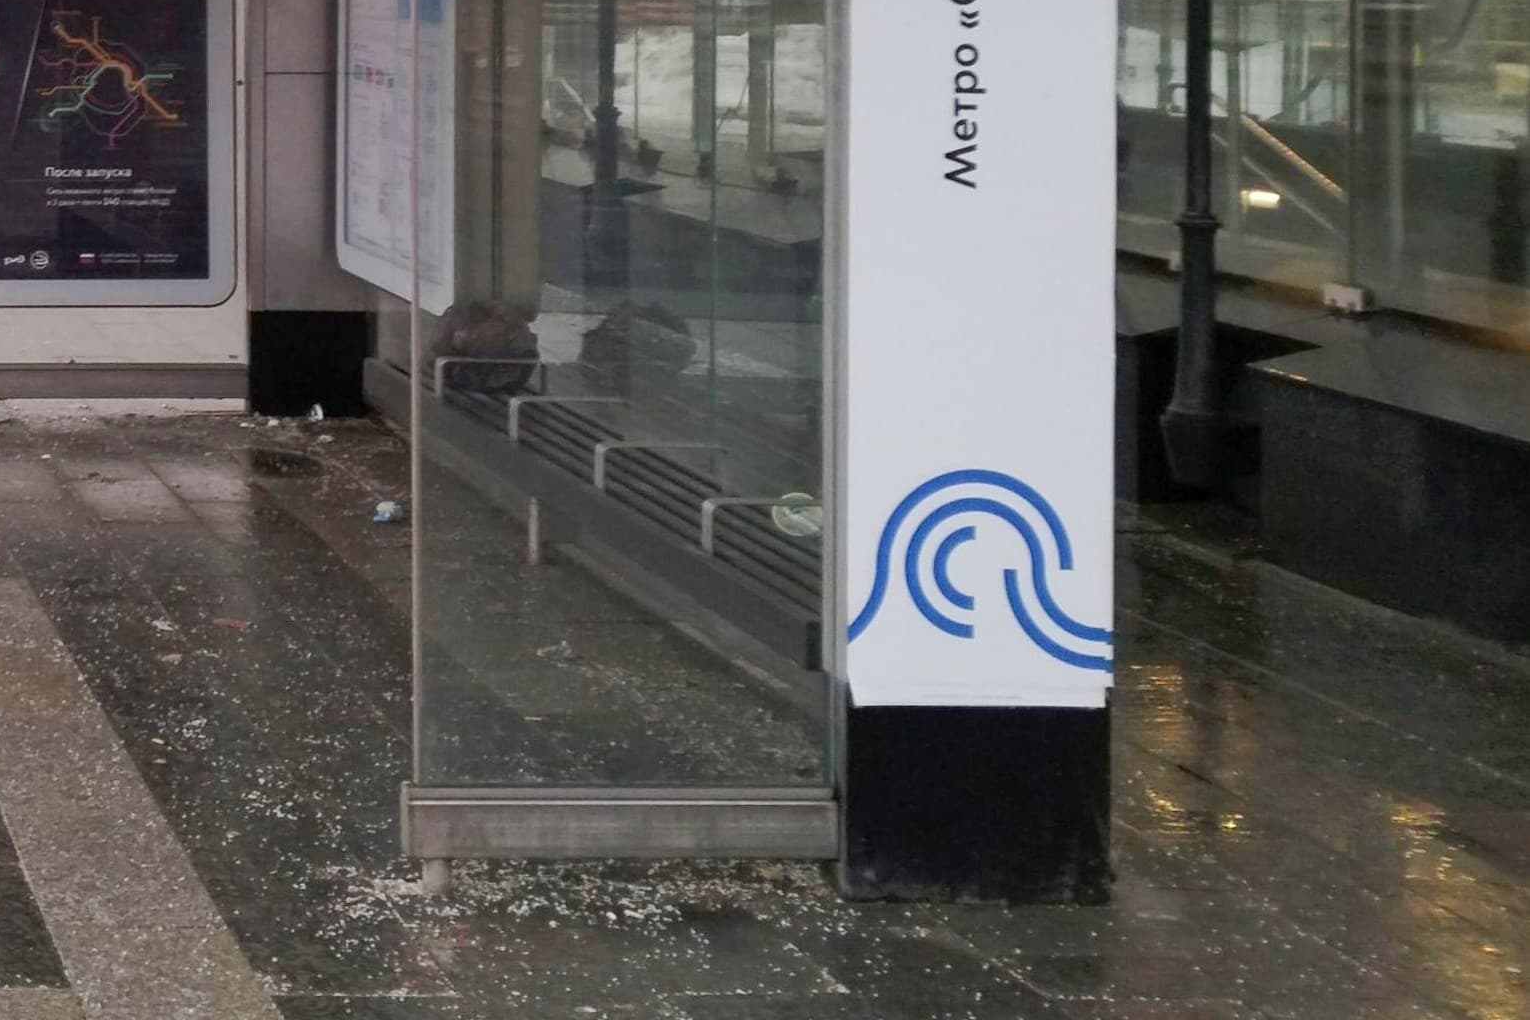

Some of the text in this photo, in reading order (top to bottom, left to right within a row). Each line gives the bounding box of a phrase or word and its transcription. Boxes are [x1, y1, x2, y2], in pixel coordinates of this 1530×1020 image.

[943, 43, 988, 189] Метро
[45, 166, 133, 180] После запуска
